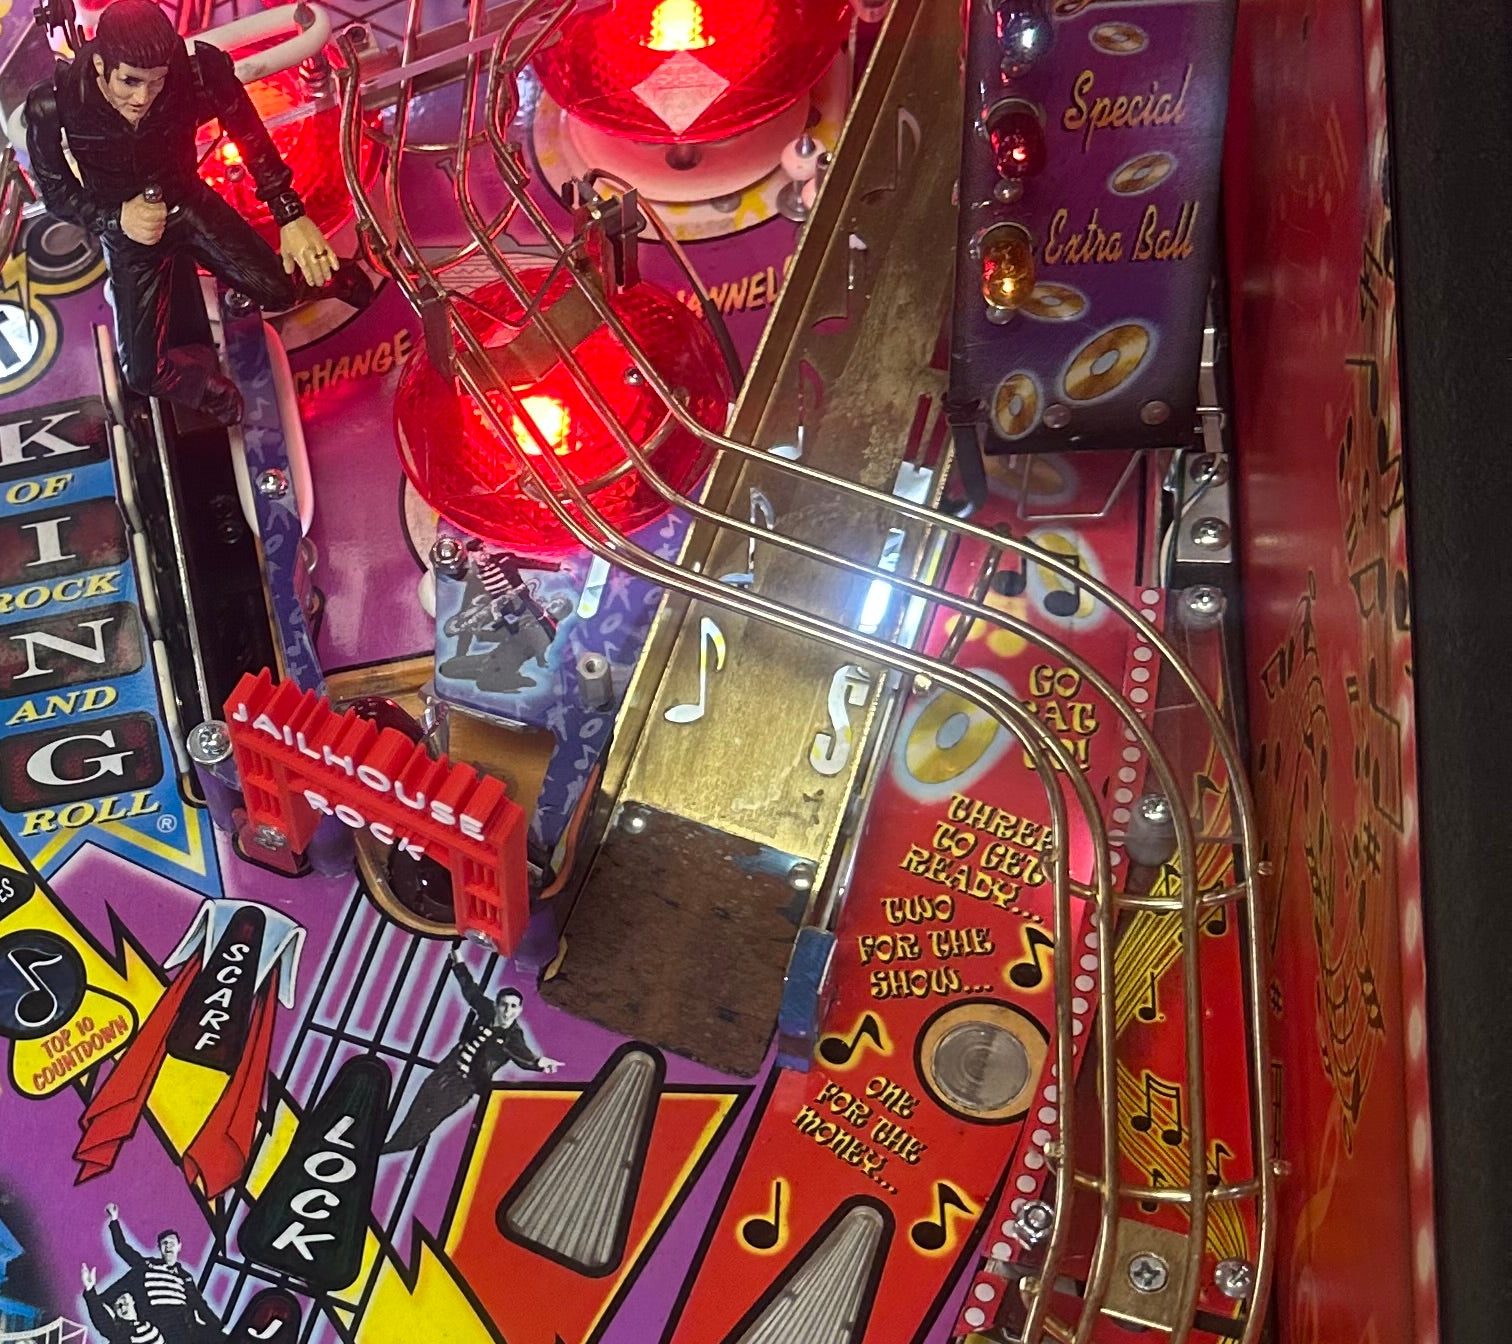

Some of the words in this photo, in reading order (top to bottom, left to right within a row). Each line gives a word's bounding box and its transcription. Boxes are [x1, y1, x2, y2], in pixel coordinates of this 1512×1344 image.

[1065, 65, 1193, 151] Special
[1044, 209, 1123, 264] Extra
[1134, 203, 1199, 262] Ball
[295, 328, 414, 398] CHANGE
[5, 472, 74, 504] OF
[7, 686, 117, 726] AND
[1029, 664, 1082, 699] GO
[232, 701, 485, 841] JAILHOUSE
[21, 791, 161, 837] ROLL
[303, 789, 426, 862] ROCK
[899, 843, 1043, 924] READY...
[933, 820, 978, 859] TO
[980, 843, 1047, 887] GET
[881, 895, 955, 925] TWO
[858, 933, 922, 965] FOR
[928, 927, 996, 959] THE
[193, 943, 250, 1051] SCARF
[870, 967, 994, 999] SHOW...
[32, 1016, 131, 1092] COUNTDOWN
[39, 1031, 71, 1060] TOP
[74, 1014, 97, 1043] 10
[814, 1079, 874, 1128] FOR
[870, 1115, 929, 1165] THE
[865, 1076, 920, 1119] ONE
[792, 1104, 899, 1195] MONEY...
[272, 1116, 357, 1262] LOCK
